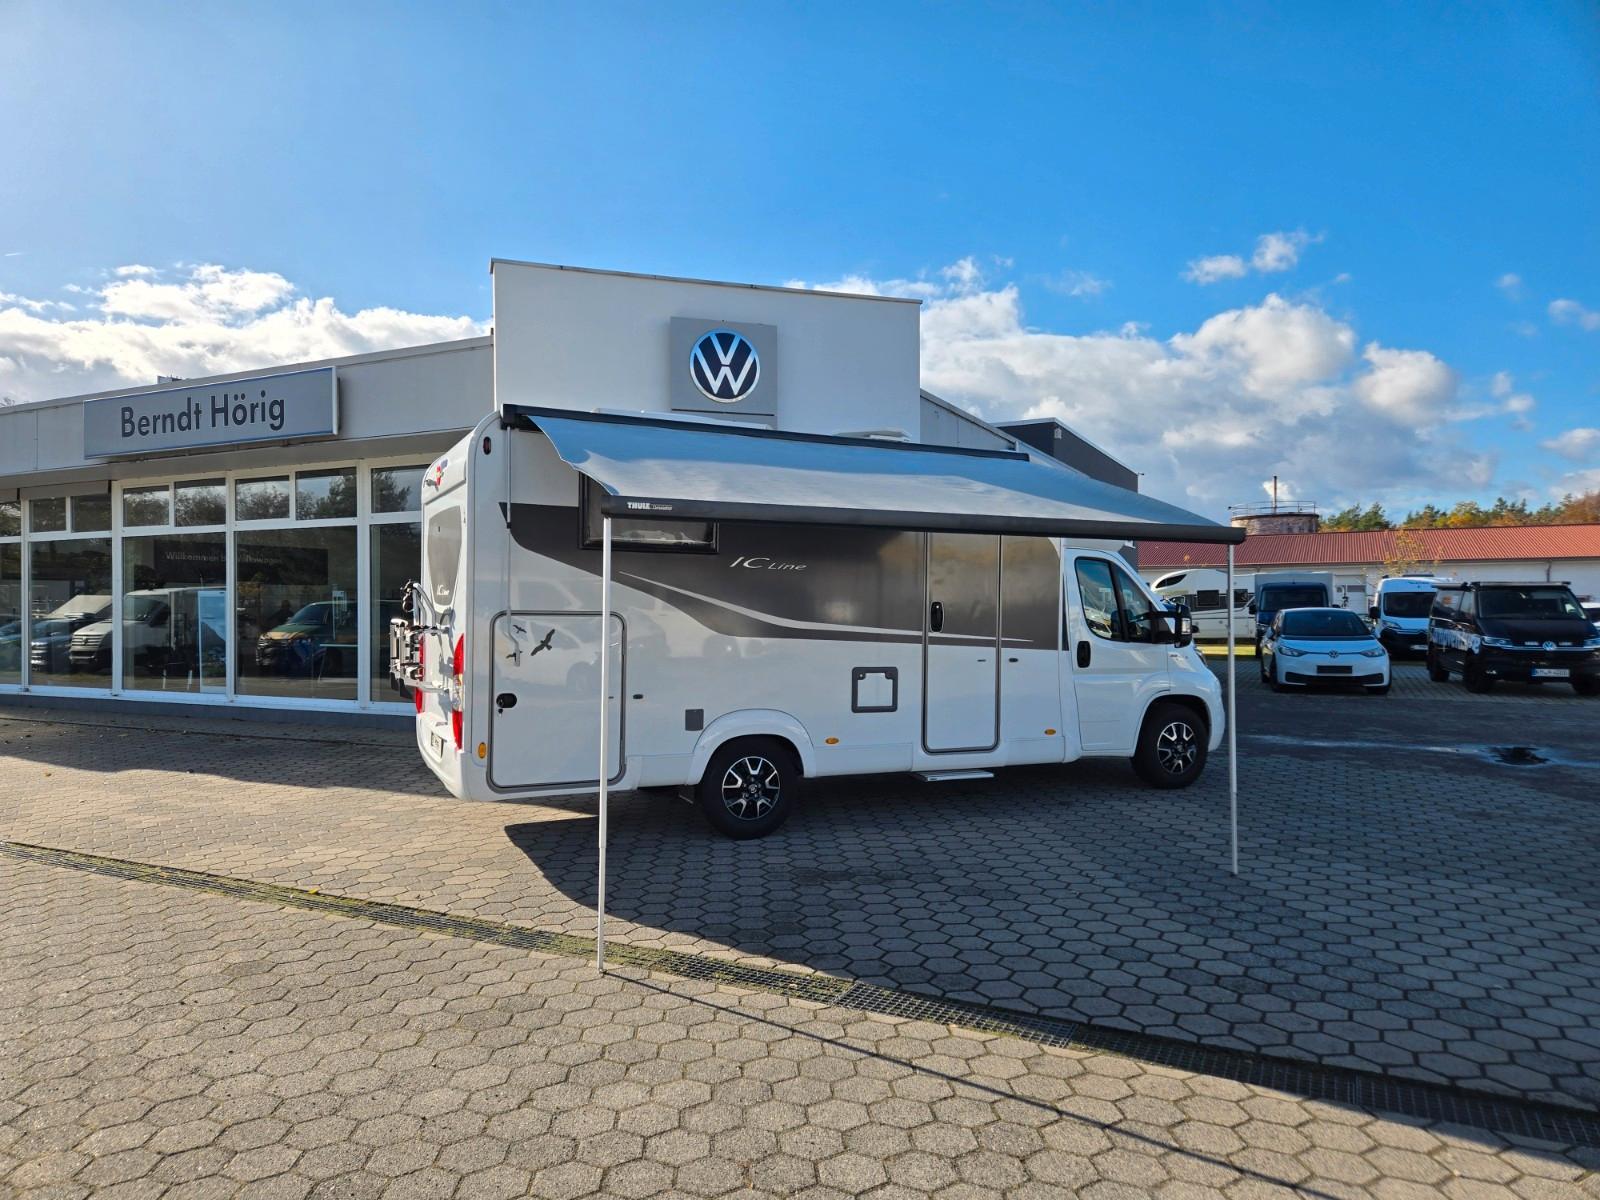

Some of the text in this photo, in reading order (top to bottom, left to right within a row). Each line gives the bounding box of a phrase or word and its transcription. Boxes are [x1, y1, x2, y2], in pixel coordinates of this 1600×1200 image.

[121, 390, 285, 437] Berndt Hörig
[627, 502, 651, 510] THULE
[768, 562, 807, 570] Line
